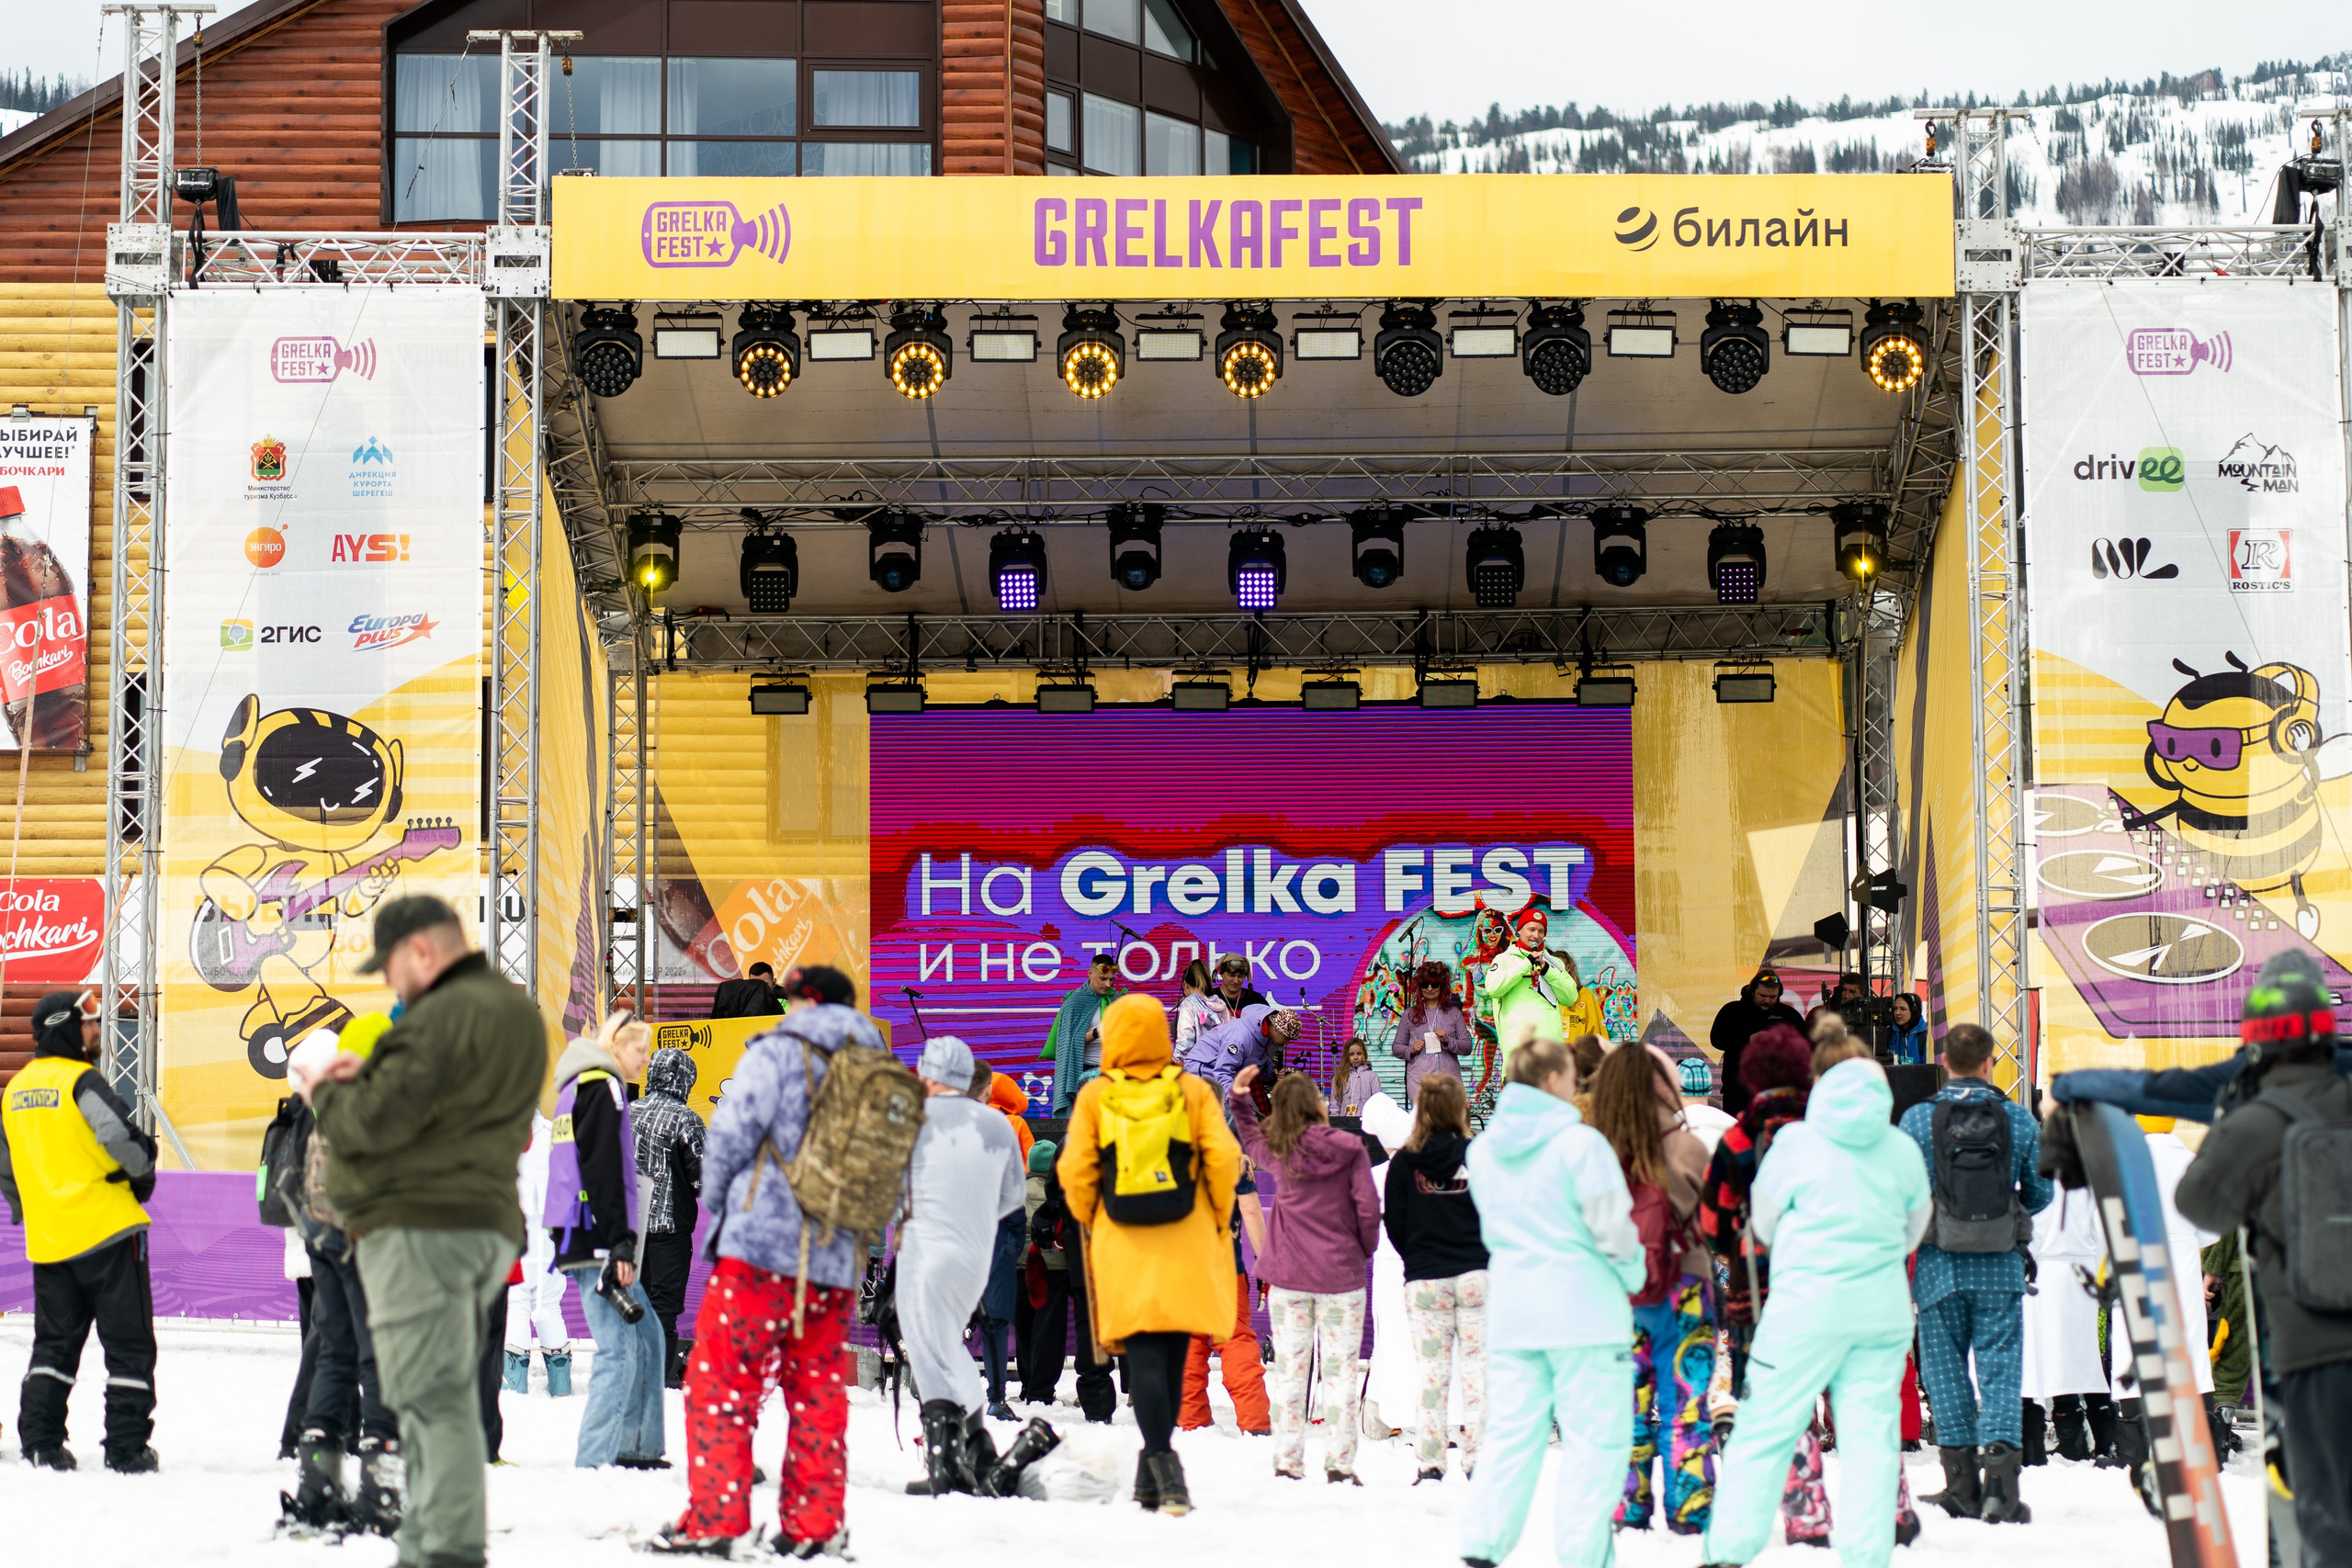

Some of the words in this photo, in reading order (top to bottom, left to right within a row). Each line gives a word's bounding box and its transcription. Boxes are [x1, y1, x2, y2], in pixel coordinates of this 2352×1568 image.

[657, 210, 727, 232] GRELKA
[1673, 206, 1849, 248] билайн
[1035, 197, 1423, 268] GRELKAFEST
[657, 236, 704, 258] FEST
[2137, 334, 2188, 350] GRELKA
[281, 343, 331, 358] GRELKA
[281, 361, 314, 376] FEST
[2138, 353, 2171, 368] FEST
[2074, 453, 2185, 484] drivee
[2218, 463, 2297, 479] MOUNTAIN
[2263, 479, 2299, 493] MAN
[243, 493, 269, 502] туризма
[248, 543, 283, 555] энгиро
[2232, 581, 2291, 591] ROSTIC'S
[347, 614, 424, 634] Europa
[261, 626, 322, 643] 2ГИС
[921, 852, 1033, 917] На
[1059, 847, 1356, 917] Grelka
[1384, 847, 1585, 912] FEST
[0, 915, 98, 950] chkari
[920, 942, 954, 982] и
[979, 942, 1062, 982] не
[662, 1029, 689, 1039] GRELKA
[662, 1039, 681, 1048] FEST
